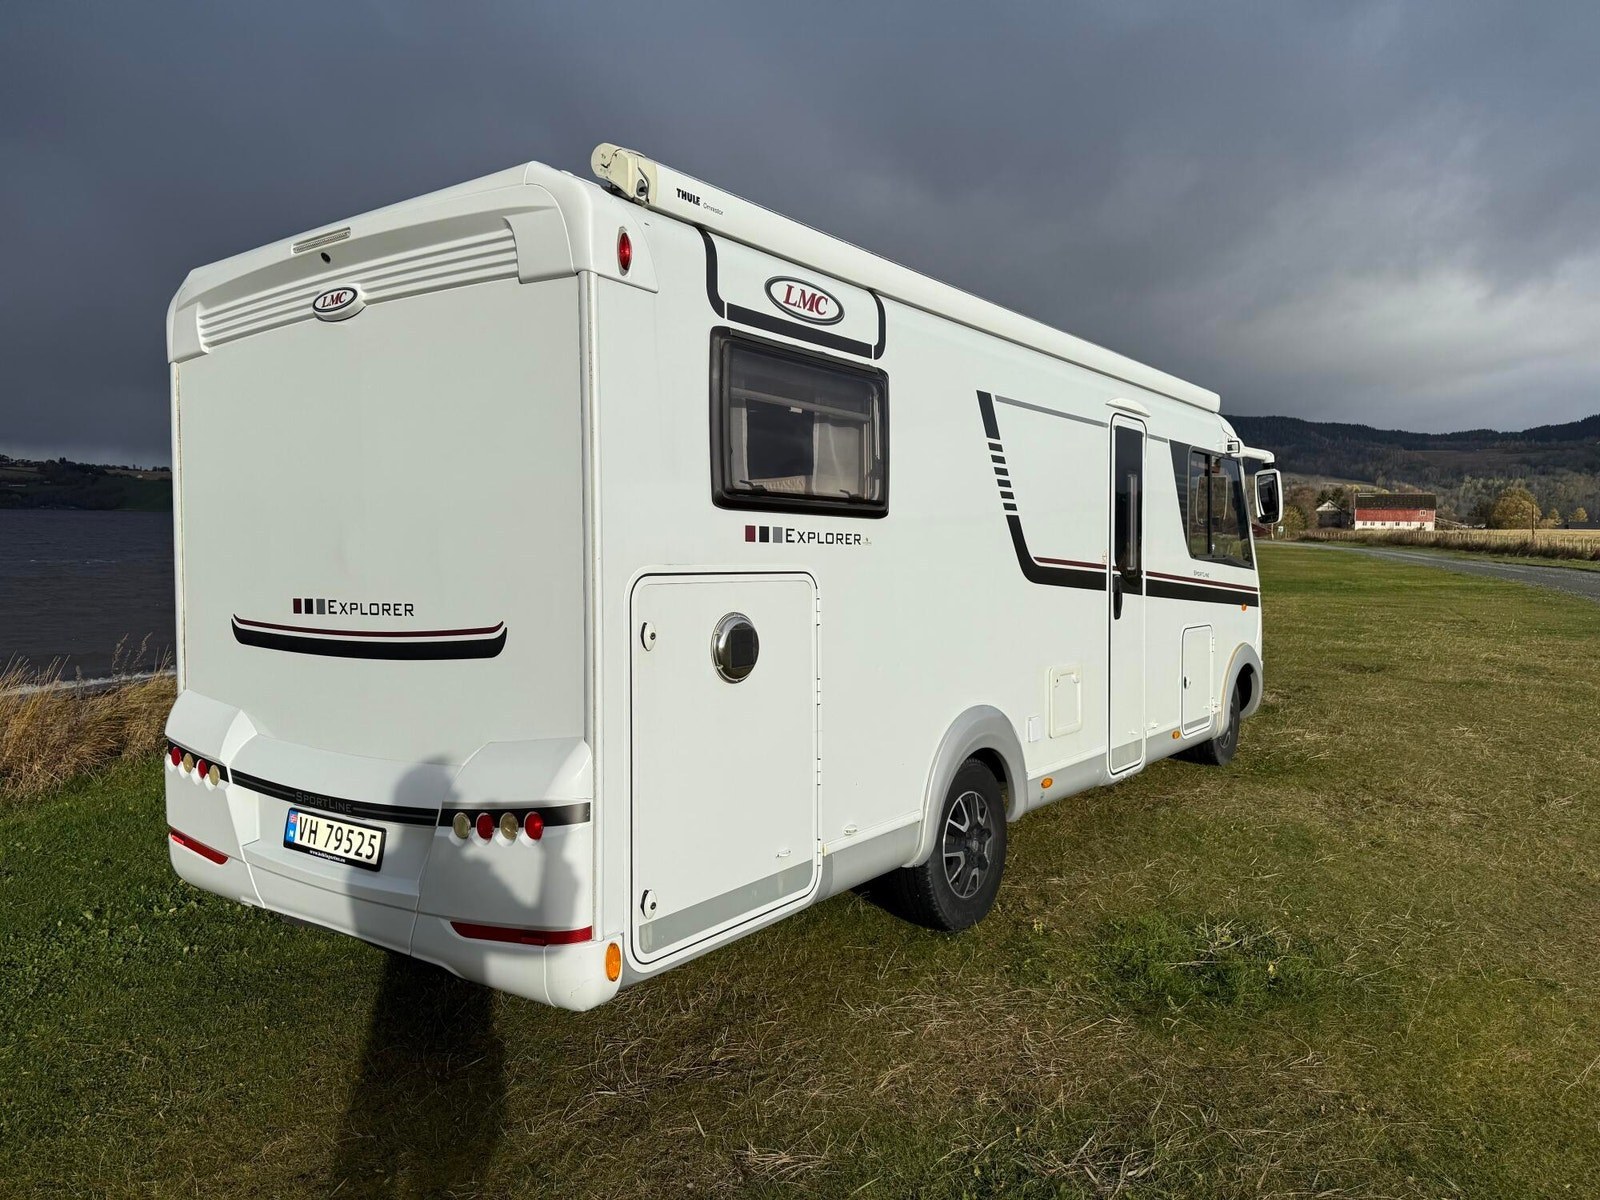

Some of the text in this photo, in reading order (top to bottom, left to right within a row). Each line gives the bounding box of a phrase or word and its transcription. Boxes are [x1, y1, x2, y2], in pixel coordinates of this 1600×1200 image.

[676, 188, 700, 206] THULE
[321, 291, 347, 308] LMC
[783, 284, 828, 315] LMC
[785, 528, 861, 545] EXPLORER
[328, 599, 414, 616] EXPLORER
[299, 816, 319, 845] VH
[324, 823, 377, 860] 79525
